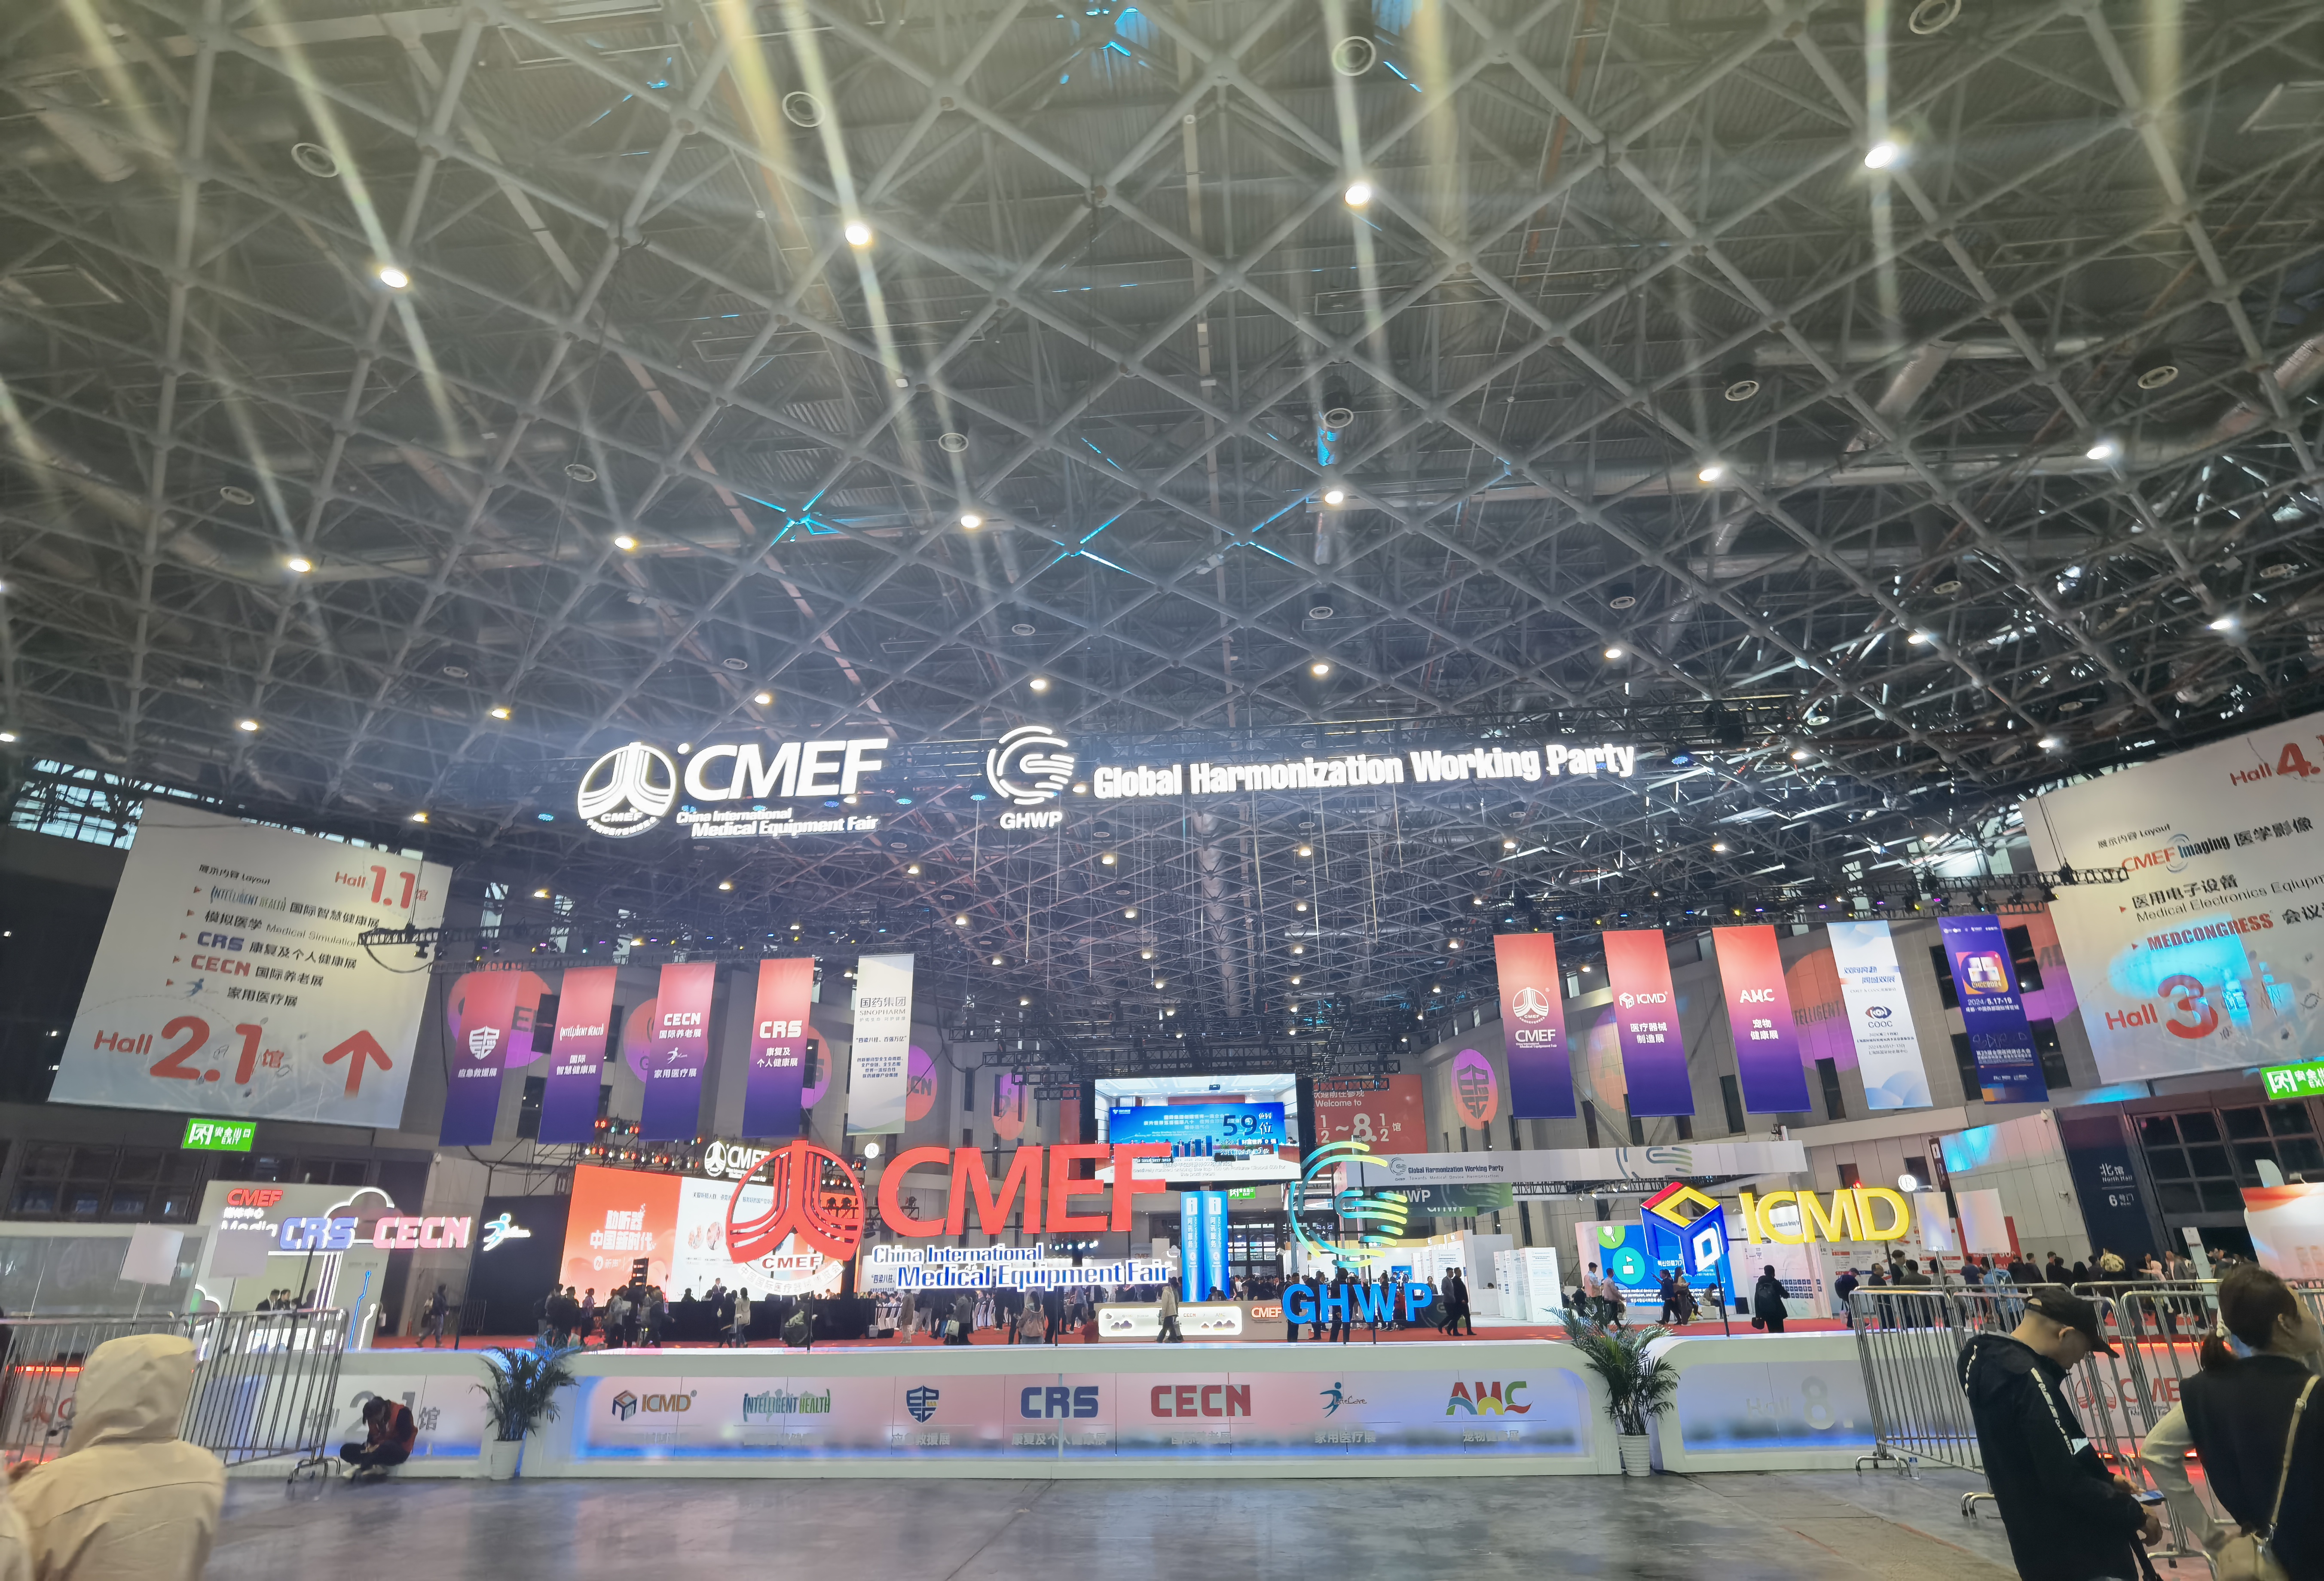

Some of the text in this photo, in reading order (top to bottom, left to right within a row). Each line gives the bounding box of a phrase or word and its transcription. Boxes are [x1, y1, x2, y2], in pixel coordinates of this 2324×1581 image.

[2230, 735, 2324, 786] Hall 4.
[684, 739, 888, 801] CMEF
[1094, 743, 1634, 799] Global Harmonization Working Party
[601, 812, 643, 822] CMEF
[676, 808, 792, 824] China International
[1000, 812, 1063, 829] GHWP
[691, 816, 878, 838] Medical Equipment Fair
[2122, 846, 2175, 872] CMEF
[335, 871, 366, 889] Hall
[370, 865, 415, 909] 1.1
[2136, 886, 2267, 923] Medical Electronics
[266, 923, 305, 939] Medical
[2147, 902, 2324, 952] MEDCONGRESS 会议
[197, 931, 356, 969] CRS 康复及个人健康展
[191, 954, 324, 987] CECN 国际养老展
[227, 986, 298, 1007] 家用医疗展
[860, 997, 906, 1007] 国药集团
[1636, 993, 1666, 1004] ICMD
[664, 1013, 701, 1026] CECN
[1752, 1019, 1771, 1029] 宠物
[2105, 1003, 2158, 1030] Hall
[659, 1029, 701, 1039] 国际养老展
[759, 1020, 802, 1038] CRS
[1515, 1029, 1555, 1042] CMEF
[1630, 1022, 1667, 1032] 医疗器械
[1750, 1030, 1779, 1041] 健康展
[1637, 1034, 1664, 1044] 制造展
[94, 1030, 153, 1055] Hall
[150, 1016, 262, 1084] 2.1
[570, 1054, 586, 1064] 国际
[766, 1047, 790, 1056] 康复及
[557, 1065, 596, 1075] 智慧健康展
[757, 1057, 798, 1068] 个人健康展
[654, 1068, 697, 1079] 家用医疗展
[1223, 1114, 1257, 1136] 59
[1392, 1123, 1401, 1132] 馆
[227, 1188, 283, 1206] CMEF
[878, 1142, 1171, 1236] CMEF
[2109, 1194, 2117, 1207] 6
[605, 1204, 645, 1231] 助听器
[1739, 1188, 1909, 1244] ICMD
[280, 1217, 358, 1250] CRS
[373, 1216, 471, 1249] CECN
[590, 1230, 656, 1251] 中国新时代
[762, 1257, 820, 1268] CMEF
[874, 1245, 1043, 1263] China International
[898, 1262, 1170, 1289] Medical Equipment Fair
[1251, 1306, 1281, 1318] CMEF
[1284, 1283, 1432, 1324] GHWP
[642, 1394, 691, 1413] ICMD
[1021, 1386, 1098, 1418] CRS
[1151, 1385, 1251, 1417] CECN
[892, 1433, 950, 1445] 应救援展
[1012, 1433, 1107, 1445] 康复及个人康展
